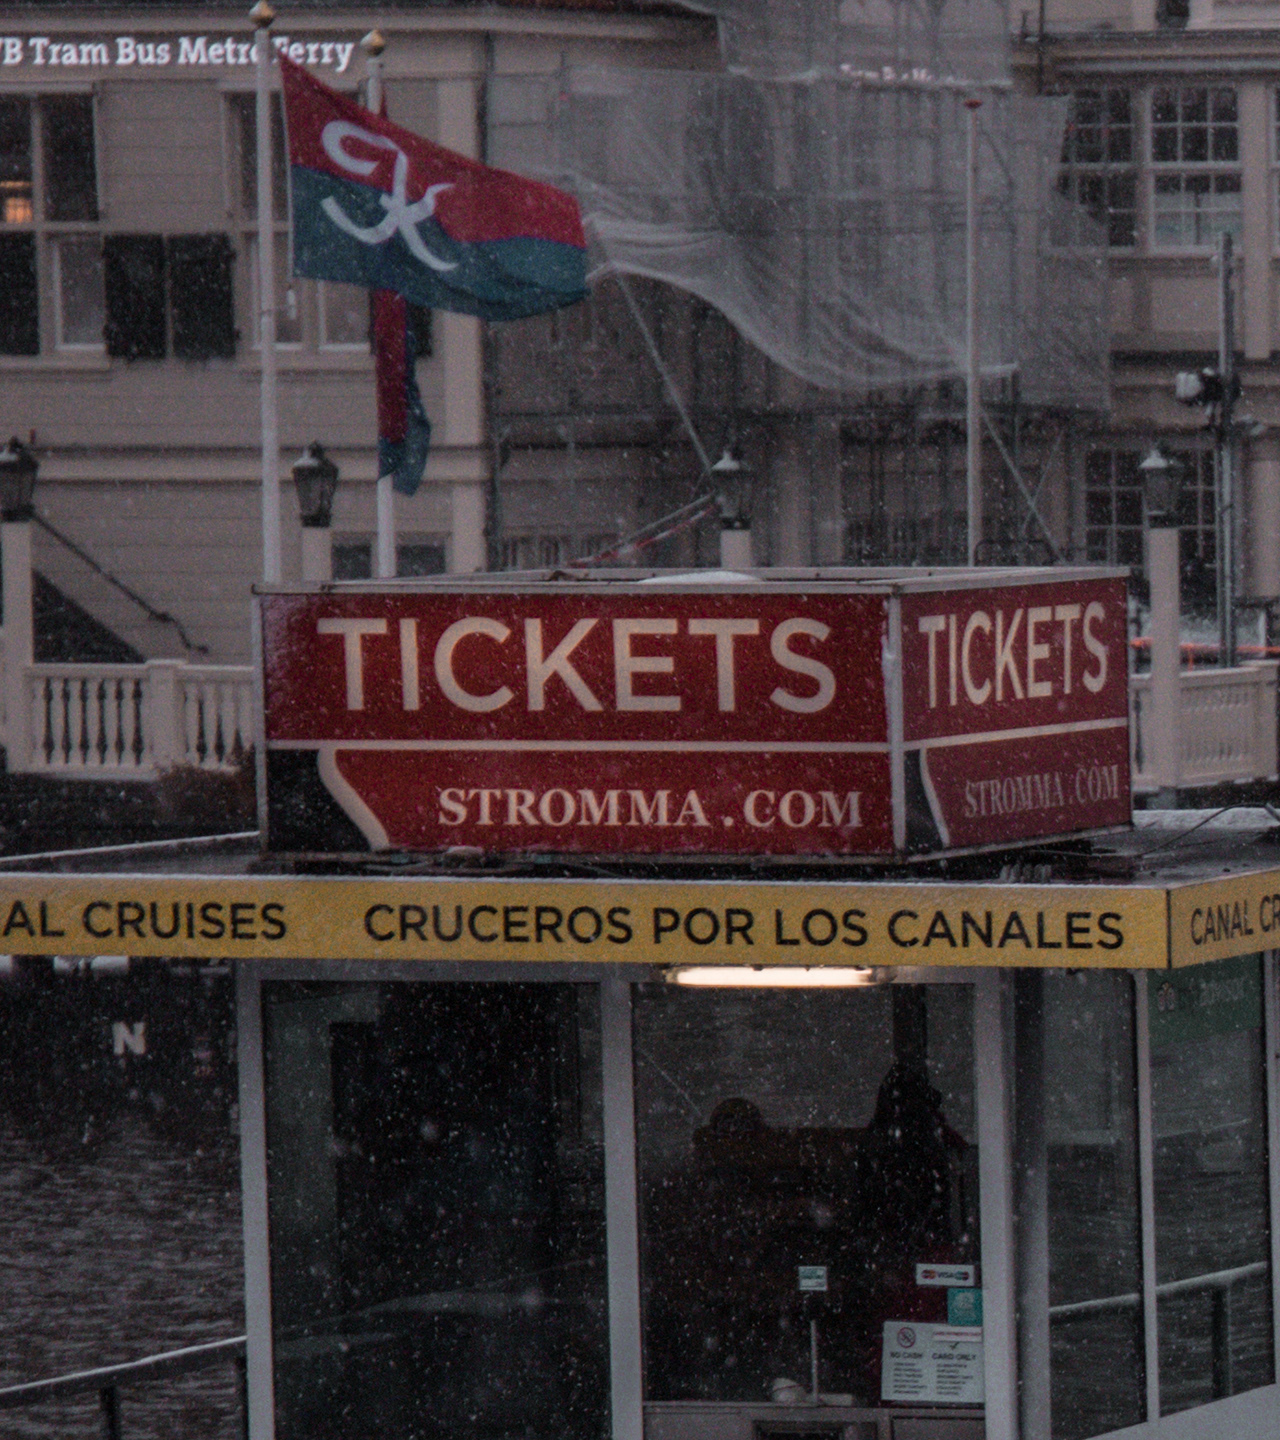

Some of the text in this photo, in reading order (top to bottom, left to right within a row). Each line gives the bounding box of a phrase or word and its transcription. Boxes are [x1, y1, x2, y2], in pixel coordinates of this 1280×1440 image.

[28, 36, 109, 65] Tram
[115, 36, 171, 65] Bus
[317, 617, 838, 714] TICKETS
[917, 601, 1110, 709] TICKETS
[82, 902, 287, 940] CRUISES
[363, 905, 1124, 950] CRUCEROS POR LOS CANALES
[1190, 893, 1254, 946] CANAL
